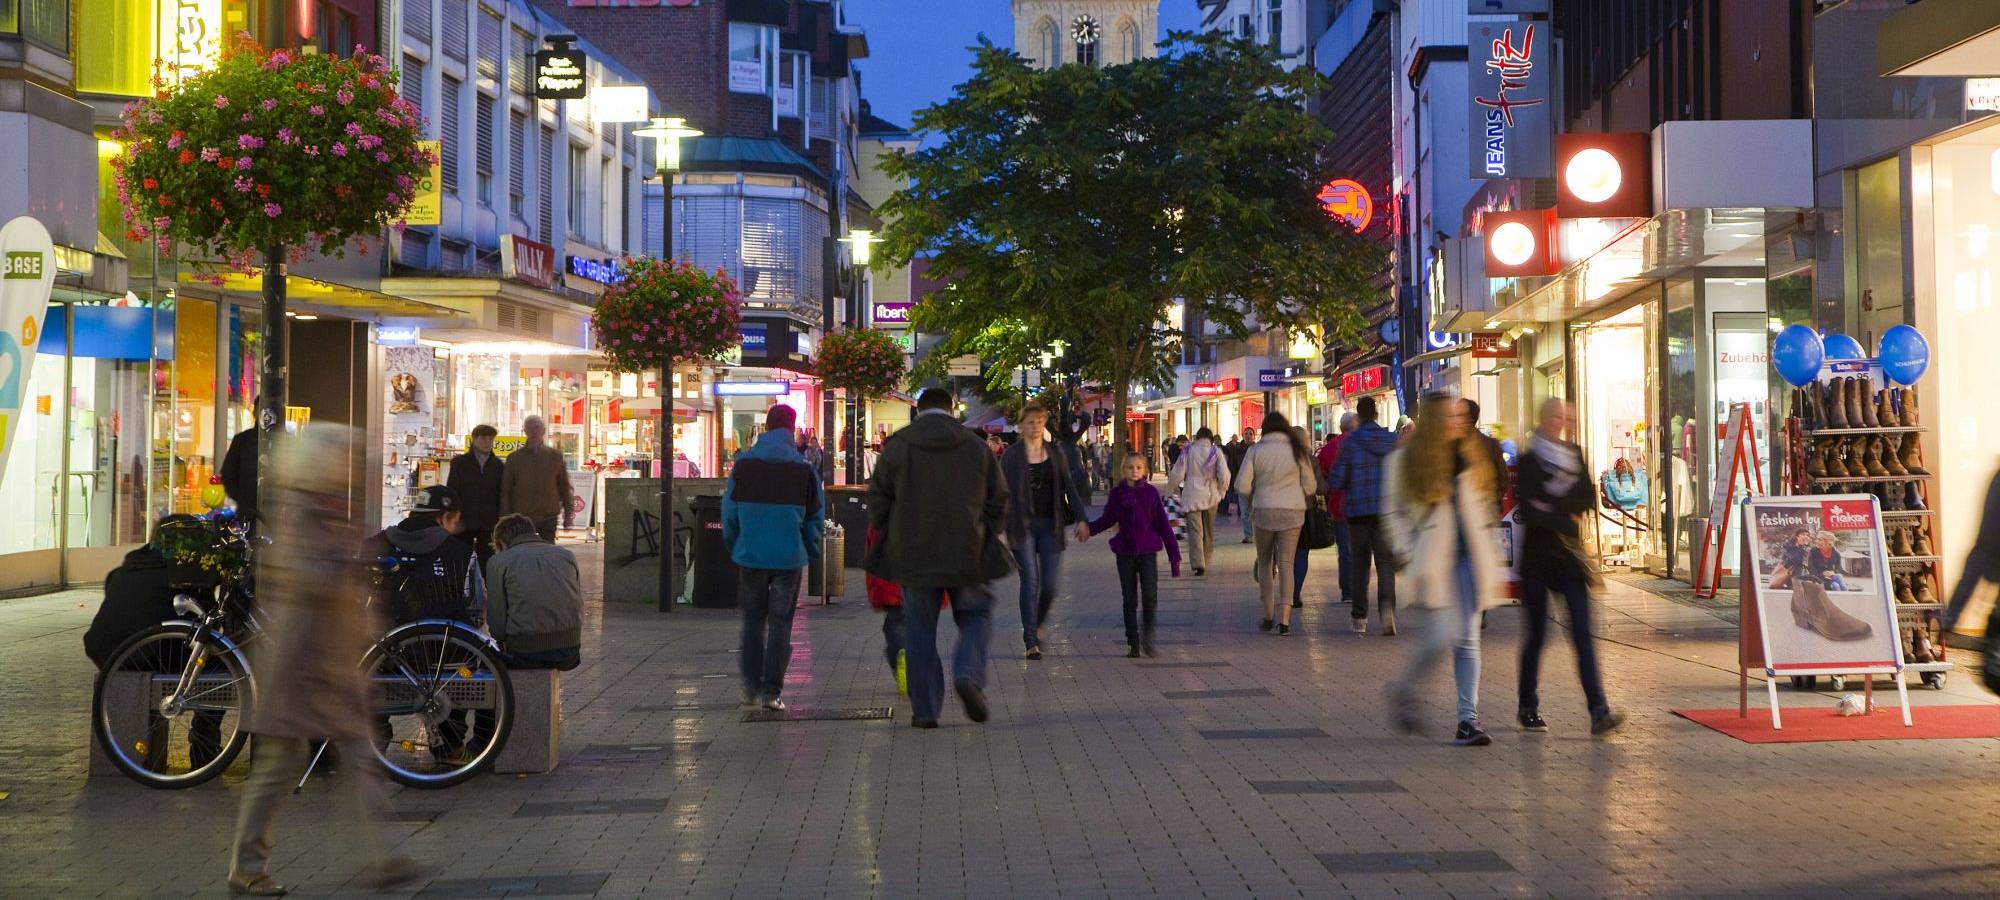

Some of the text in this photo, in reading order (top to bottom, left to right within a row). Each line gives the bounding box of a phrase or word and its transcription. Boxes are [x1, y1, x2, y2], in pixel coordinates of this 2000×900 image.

[1475, 24, 1543, 127] fritz
[1487, 109, 1504, 175] JEANS
[3, 256, 40, 273] BASE
[516, 242, 544, 280] JILLY
[1760, 511, 1821, 528] fashion by
[1830, 512, 1870, 523] rieker
